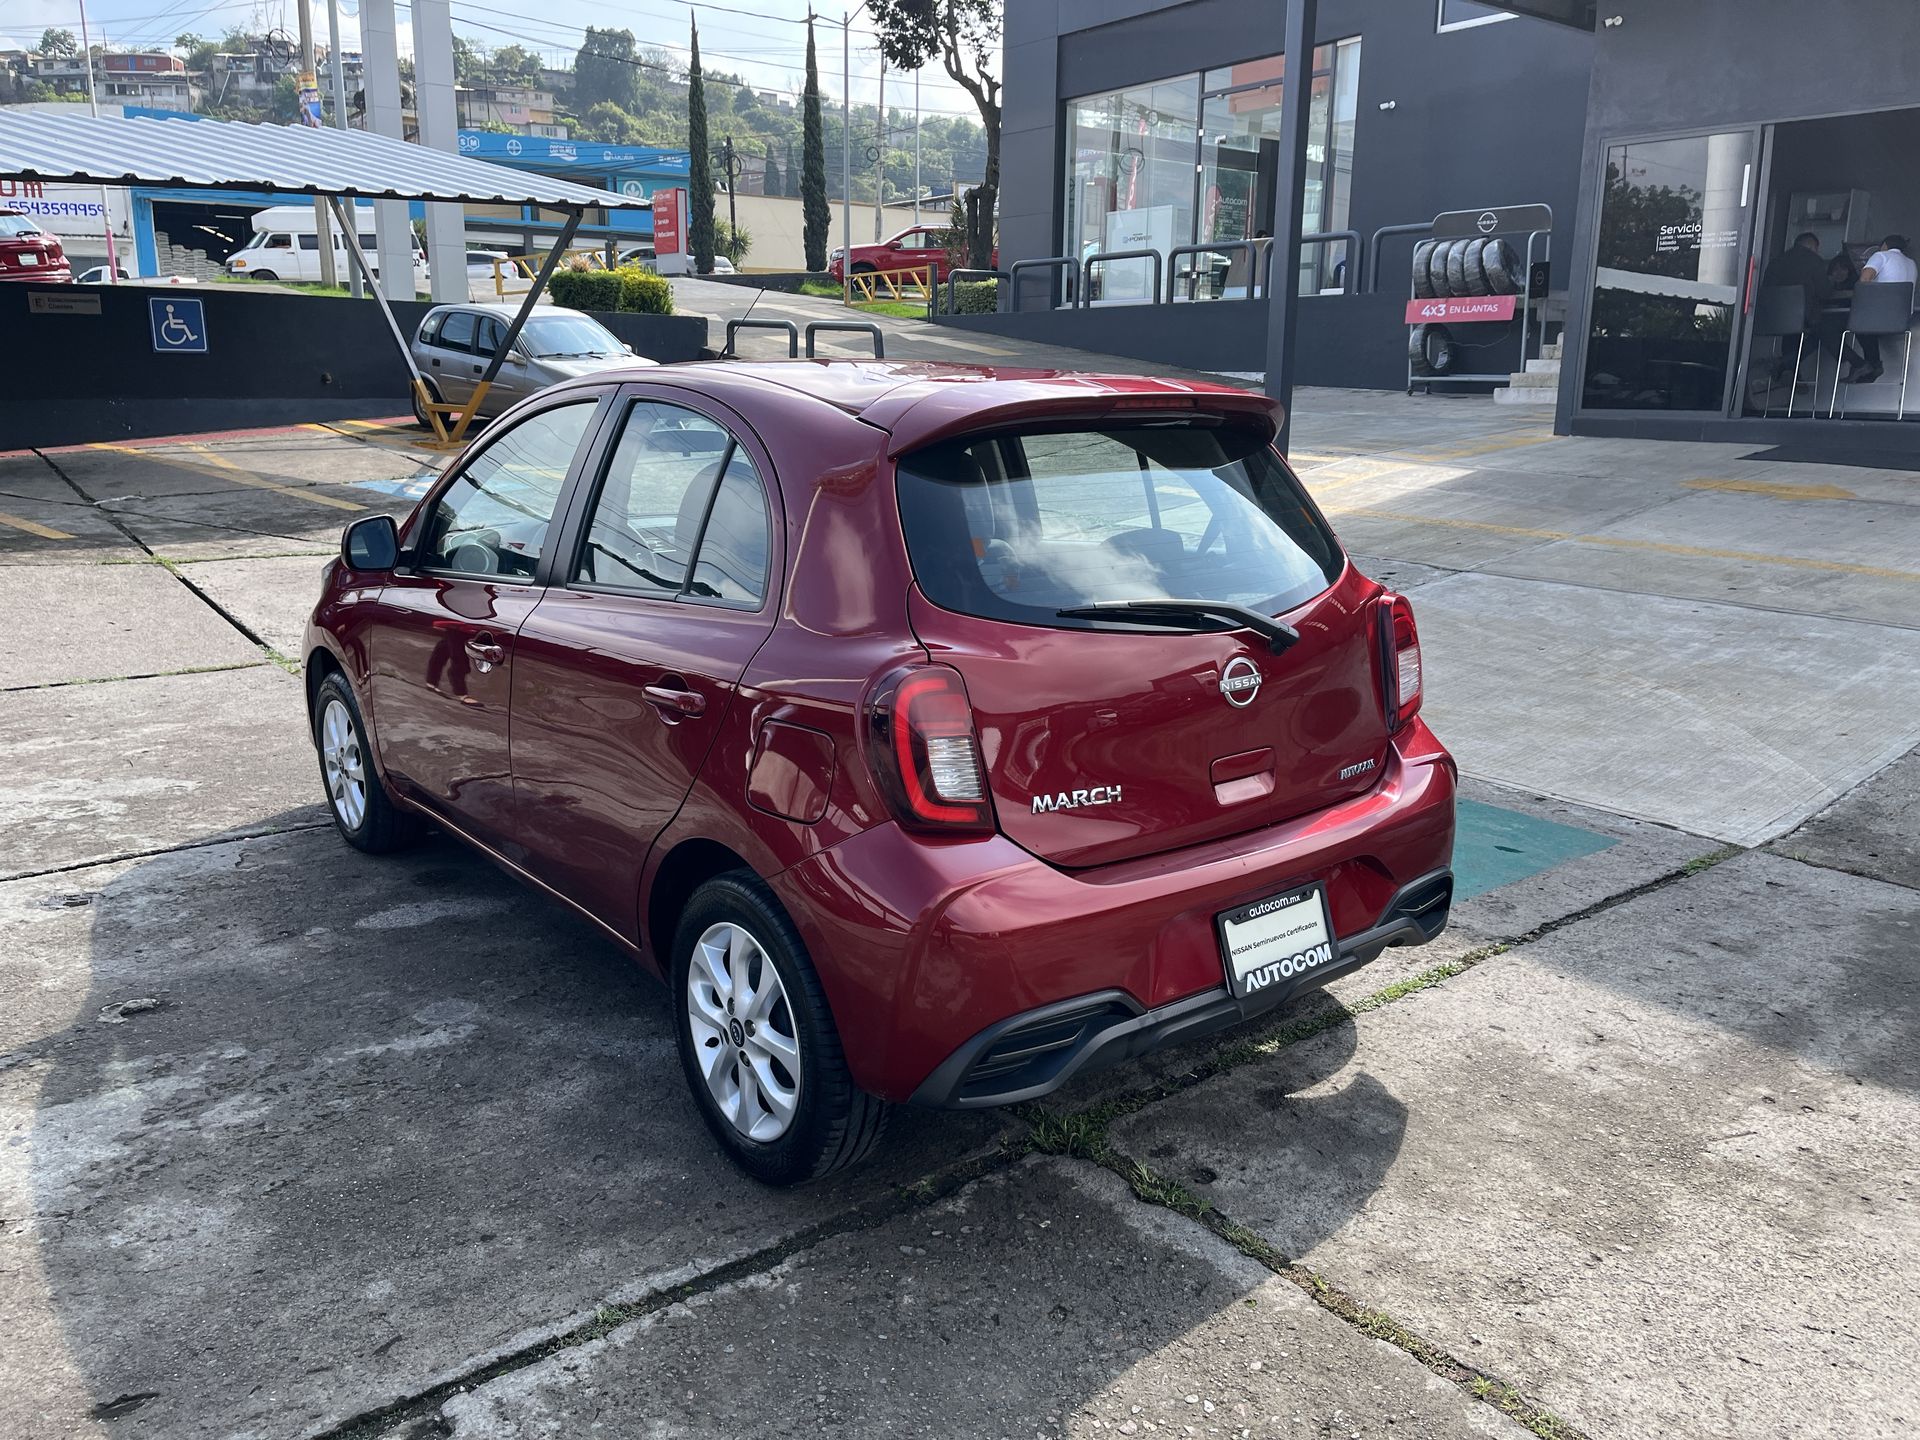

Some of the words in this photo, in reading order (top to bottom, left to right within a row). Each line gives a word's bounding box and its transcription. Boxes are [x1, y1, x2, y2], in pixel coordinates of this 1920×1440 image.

[1218, 195, 1248, 206] Autocom
[1660, 222, 1702, 235] Servicio
[1421, 304, 1447, 317] 4x3
[1449, 305, 1462, 314] EN
[1462, 303, 1499, 314] LLANTAS
[1221, 676, 1262, 691] NISSAN
[1032, 784, 1122, 814] MARCH
[1249, 895, 1301, 917] autocom.mx
[1231, 944, 1253, 956] NISSAN
[1253, 931, 1287, 949] Seminuevos
[1286, 921, 1318, 937] Certificados
[1246, 943, 1333, 992] AUTOCOM
